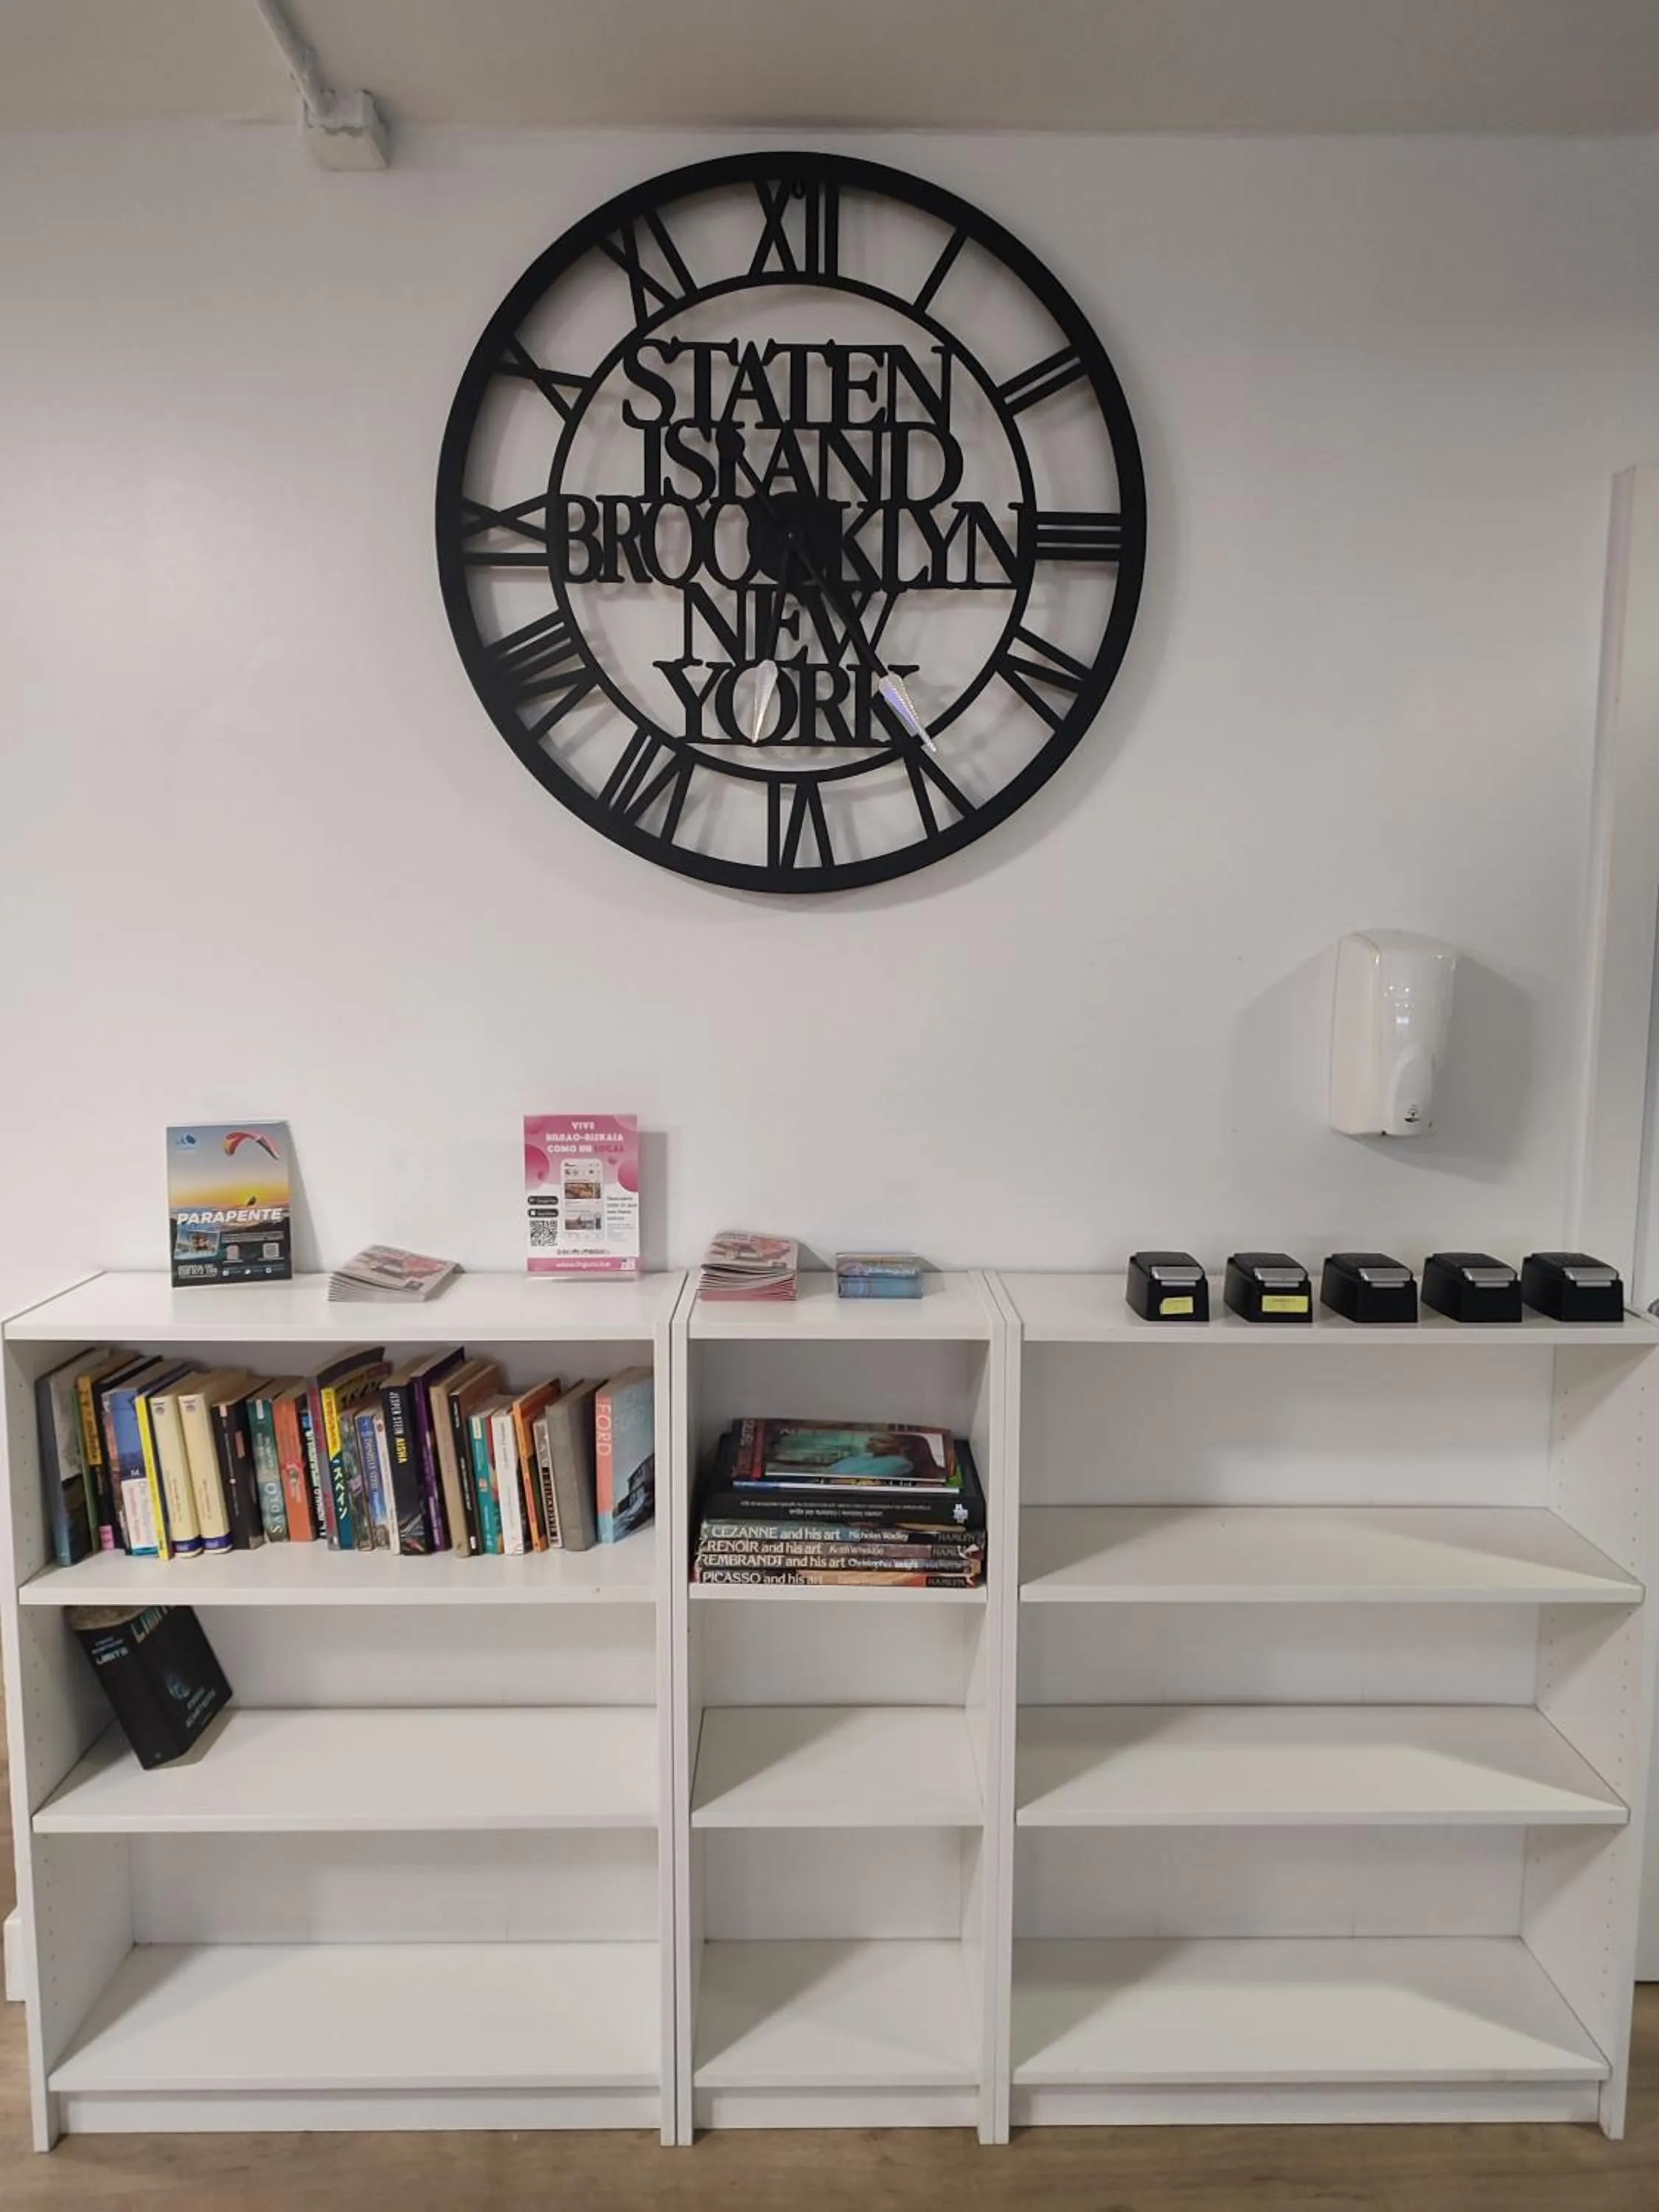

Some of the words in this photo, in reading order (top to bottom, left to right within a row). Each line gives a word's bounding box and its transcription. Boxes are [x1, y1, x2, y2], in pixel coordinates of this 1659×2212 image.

[622, 337, 953, 430] STATEN
[641, 421, 964, 504] ISLAND
[557, 494, 1026, 590] BROOKLYN
[681, 582, 901, 666] NEW
[653, 659, 920, 748] YORK
[571, 1121, 595, 1130] VIVE
[546, 1144, 577, 1153] COMO
[176, 1208, 284, 1225] PARAPENTE
[597, 1403, 613, 1457] FORD
[333, 1467, 348, 1520] スペイン
[707, 1540, 759, 1552] RENOIR
[761, 1542, 784, 1553] and
[785, 1542, 803, 1554] his
[804, 1543, 822, 1554] art
[712, 1526, 778, 1539] CEZANNE
[779, 1528, 803, 1540] and
[804, 1528, 822, 1540] his
[823, 1528, 841, 1540] art
[700, 1554, 785, 1566] REMBRANDT
[785, 1555, 808, 1567] and
[810, 1555, 827, 1568] his
[829, 1557, 846, 1568] art
[703, 1571, 762, 1584] PICASSO
[763, 1572, 785, 1584] and
[787, 1573, 804, 1585] his
[806, 1575, 823, 1585] art
